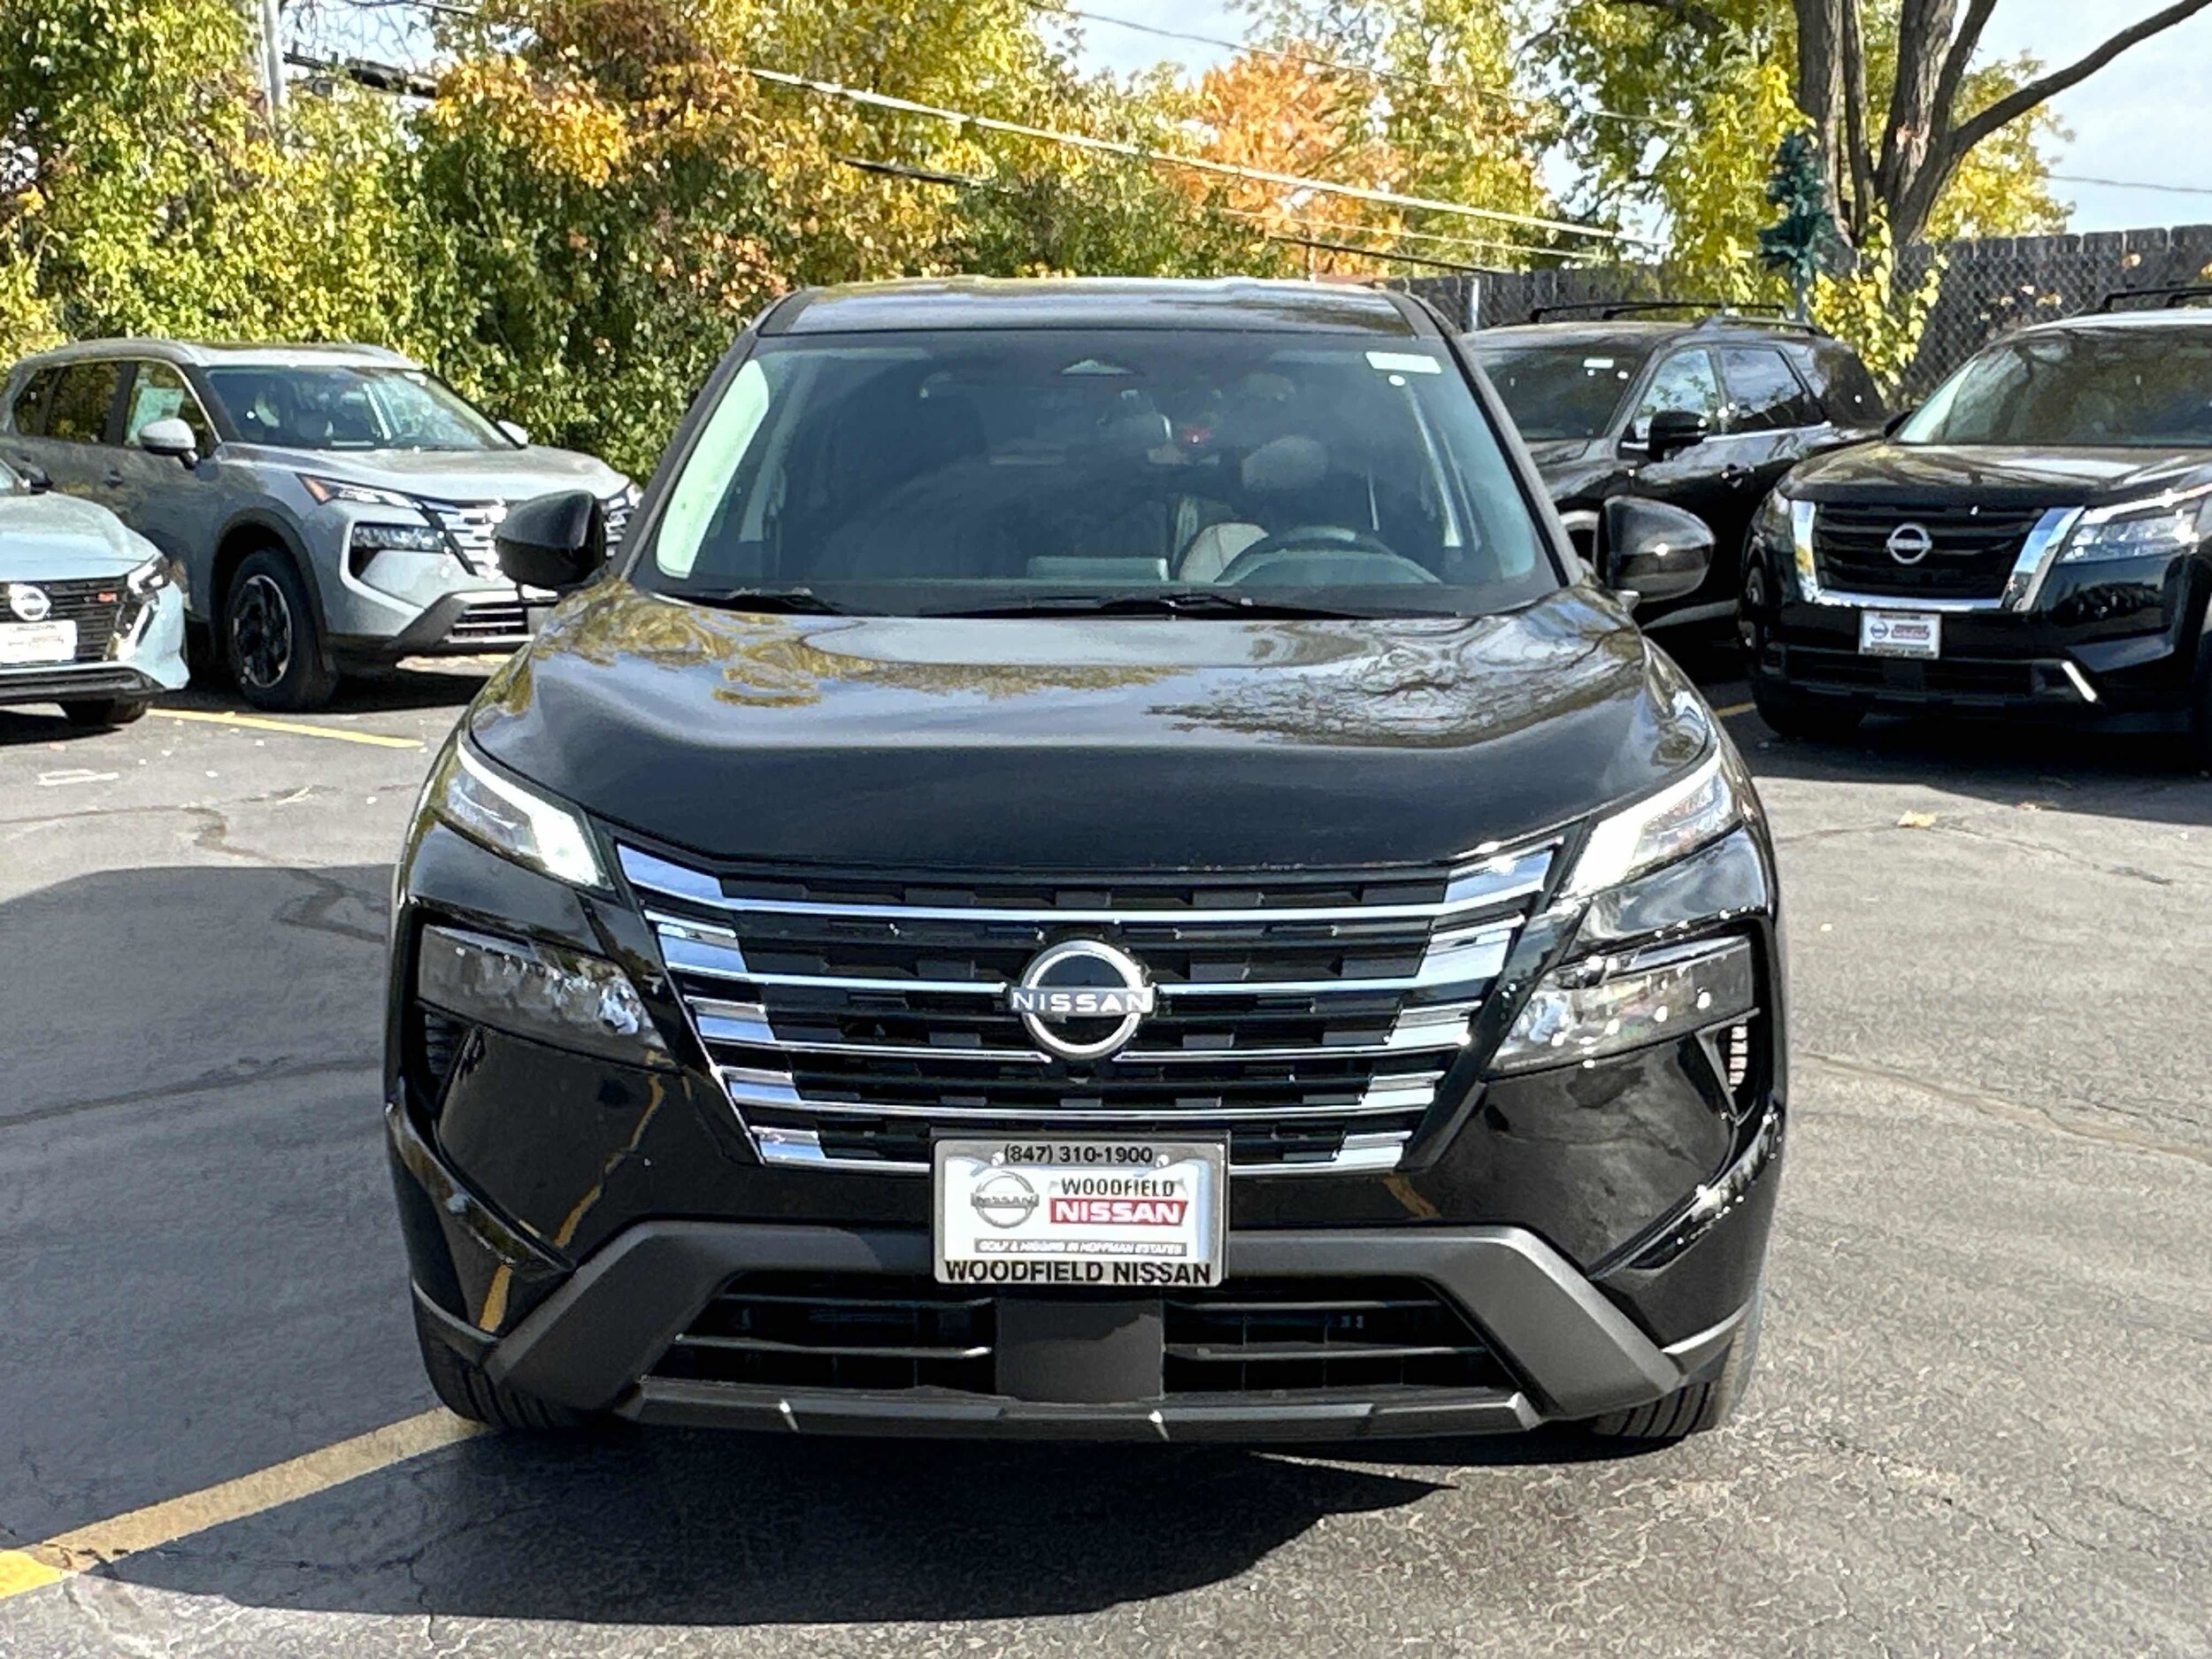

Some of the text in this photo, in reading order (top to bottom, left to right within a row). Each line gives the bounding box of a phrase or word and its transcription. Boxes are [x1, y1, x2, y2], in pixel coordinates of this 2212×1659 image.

[1011, 991, 1150, 1012] NISSAN
[1003, 1144, 1154, 1164] (847) 310-1900
[1061, 1177, 1175, 1197] WOODFIELD
[1054, 1202, 1180, 1223] NISSAN
[945, 1260, 1211, 1284] WOODFIELD NISSAN
